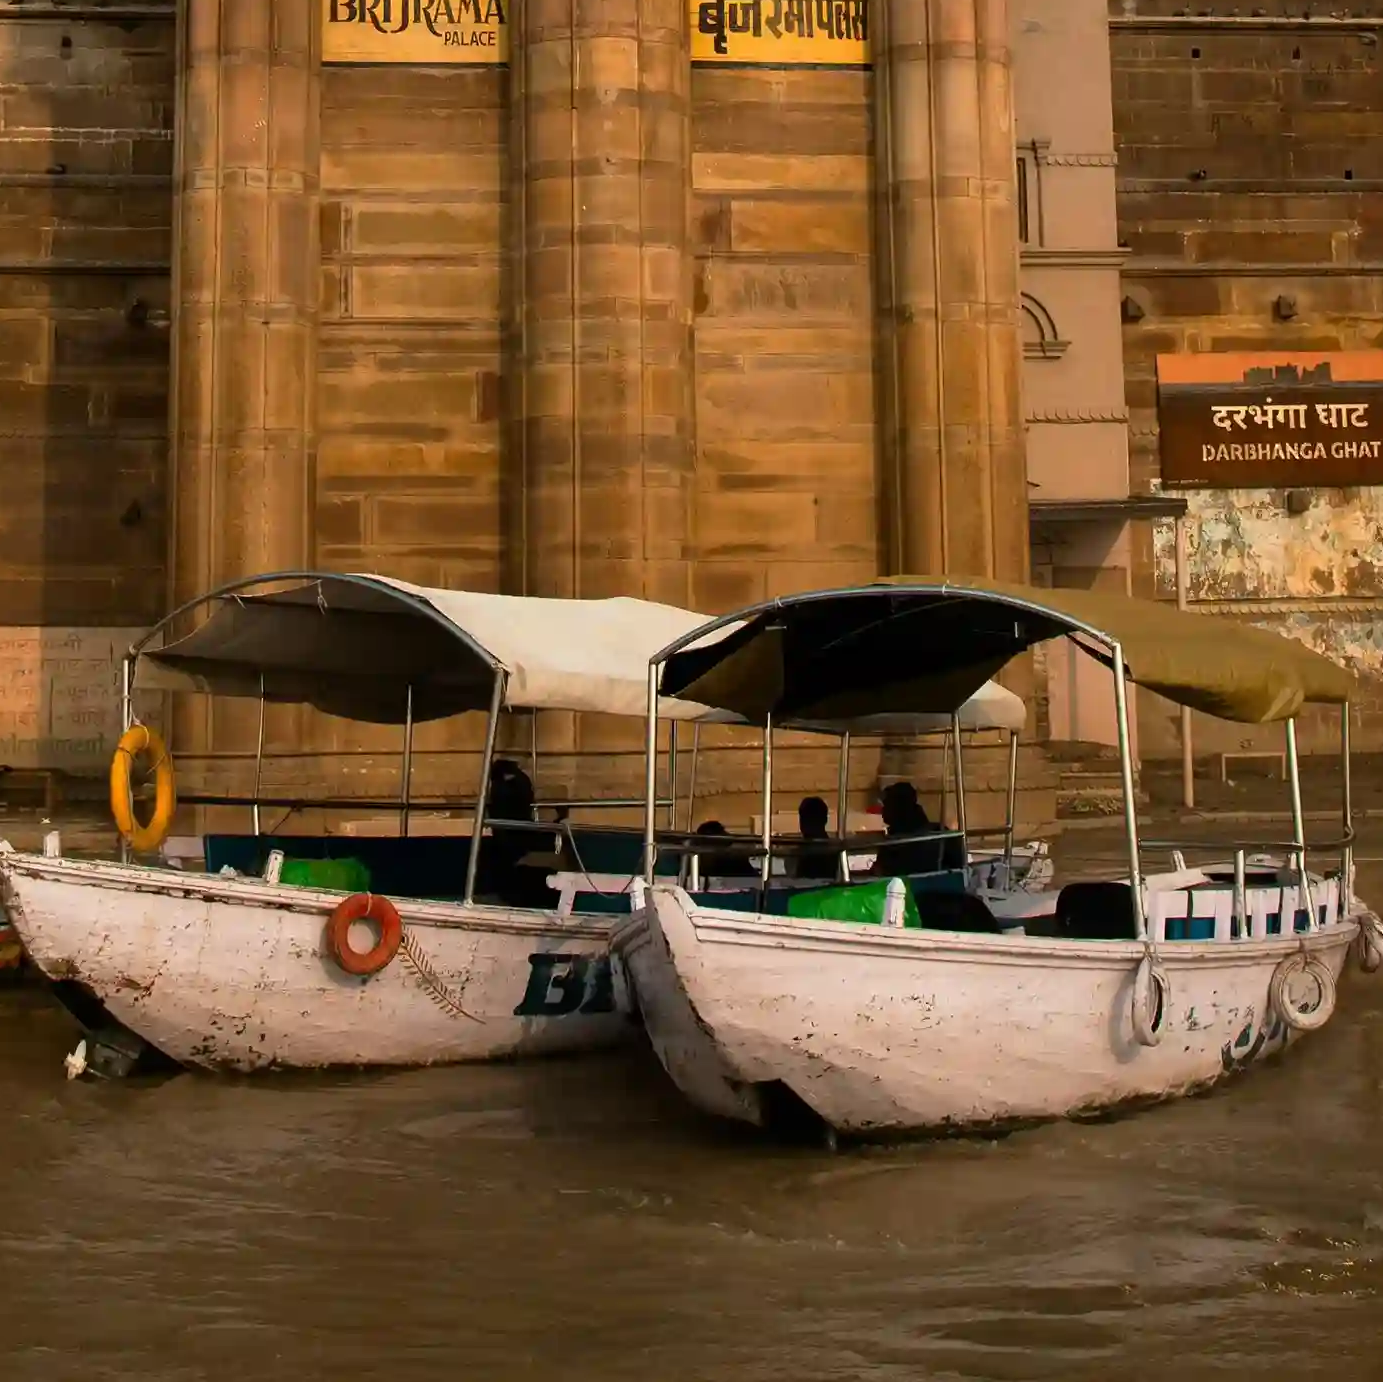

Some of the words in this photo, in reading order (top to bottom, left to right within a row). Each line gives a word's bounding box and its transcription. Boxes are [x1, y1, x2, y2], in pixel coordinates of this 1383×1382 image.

[443, 30, 496, 47] PALACE
[1210, 396, 1308, 432] दरभंगा
[1315, 403, 1369, 429] घाट
[1201, 441, 1328, 462] DARBHANGA
[1330, 440, 1382, 459] GHAT
